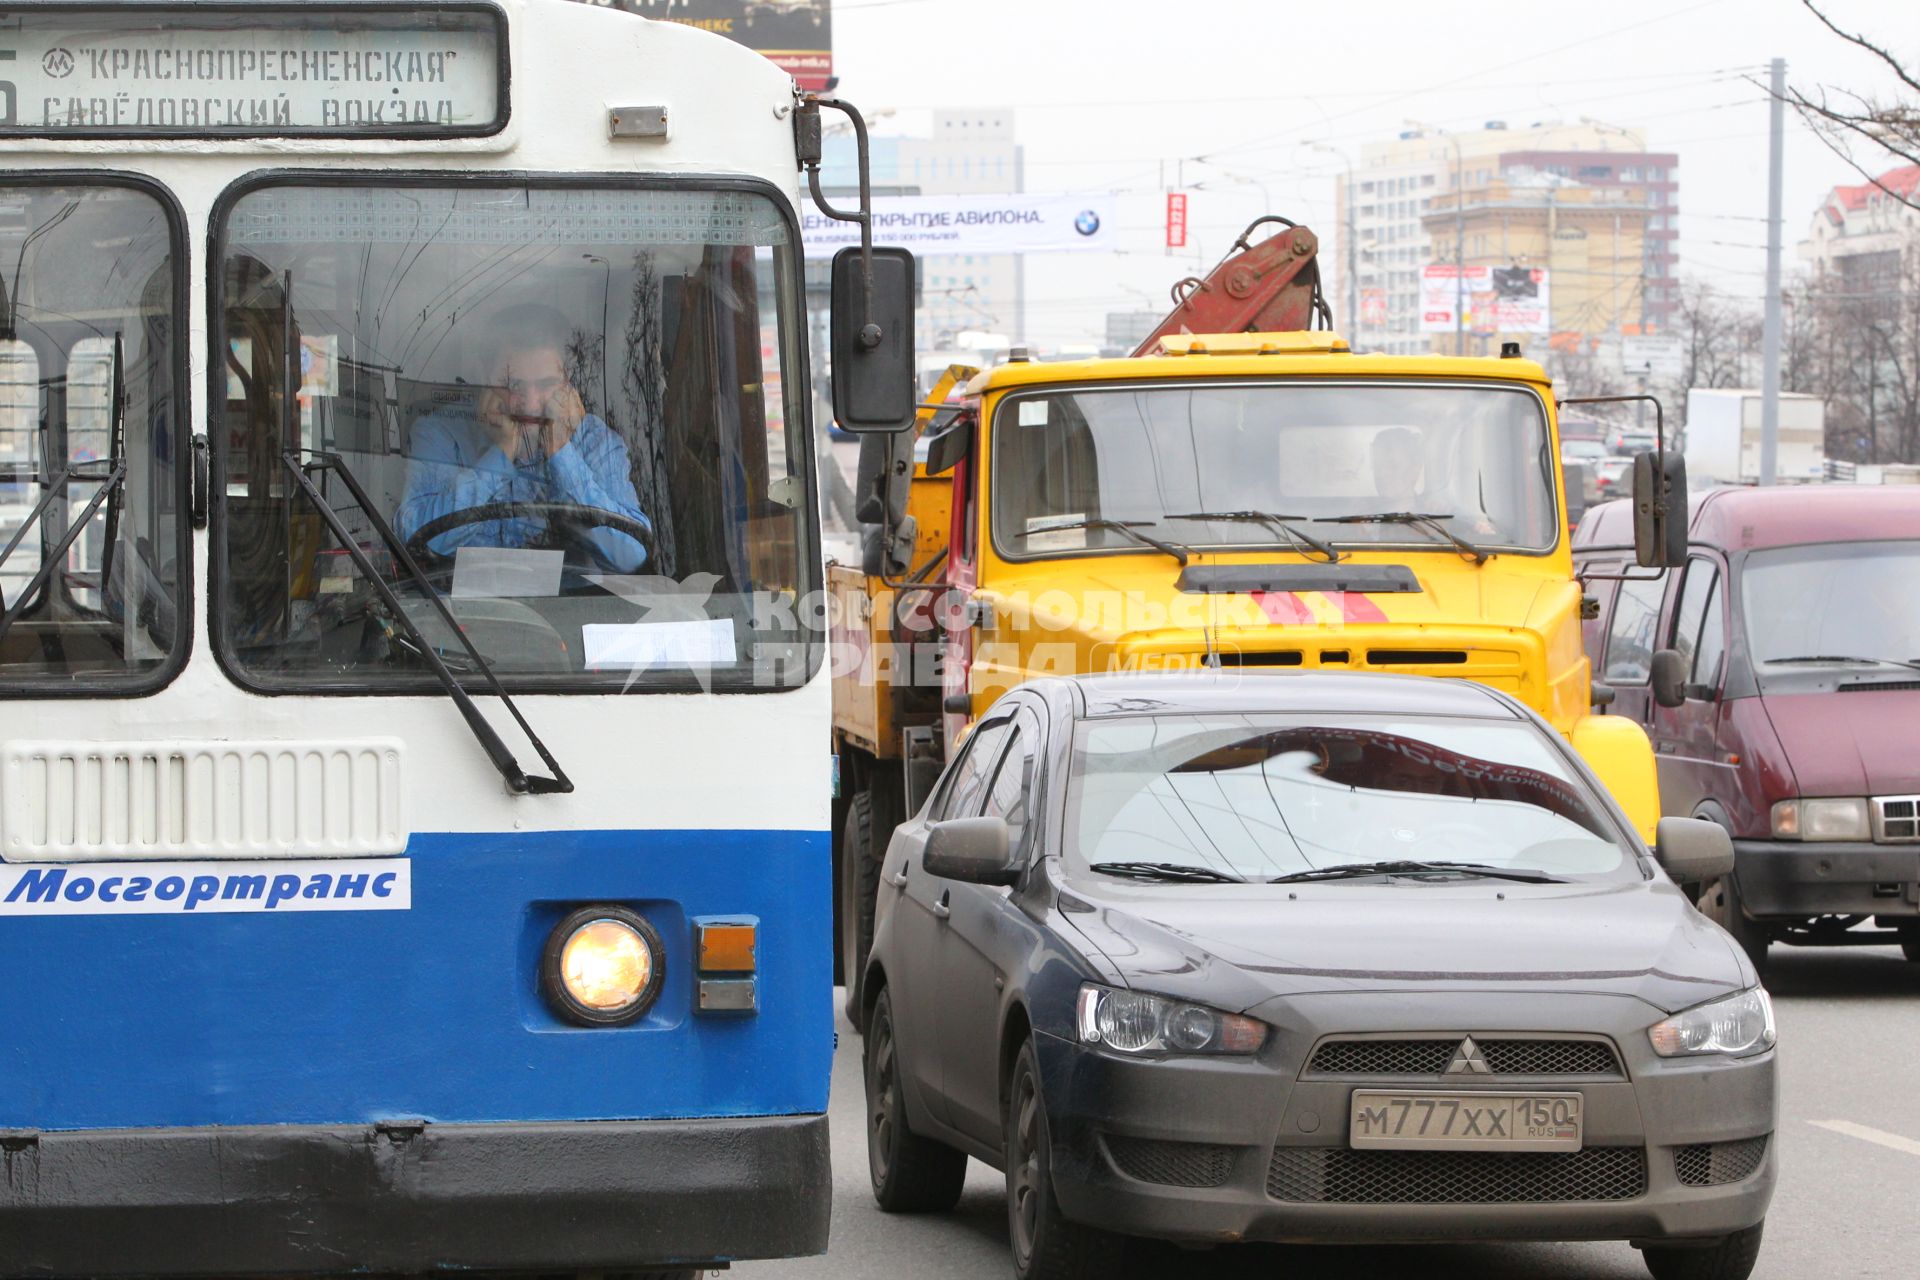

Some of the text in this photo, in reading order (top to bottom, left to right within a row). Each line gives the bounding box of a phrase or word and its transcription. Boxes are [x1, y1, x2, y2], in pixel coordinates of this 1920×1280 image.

[43, 92, 452, 125] САВЁЛОВСКИЙ ВОКЗАЛ
[4, 868, 397, 911] Мосгортранс
[1516, 1099, 1569, 1127] 150
[1527, 1126, 1554, 1137] RUS
